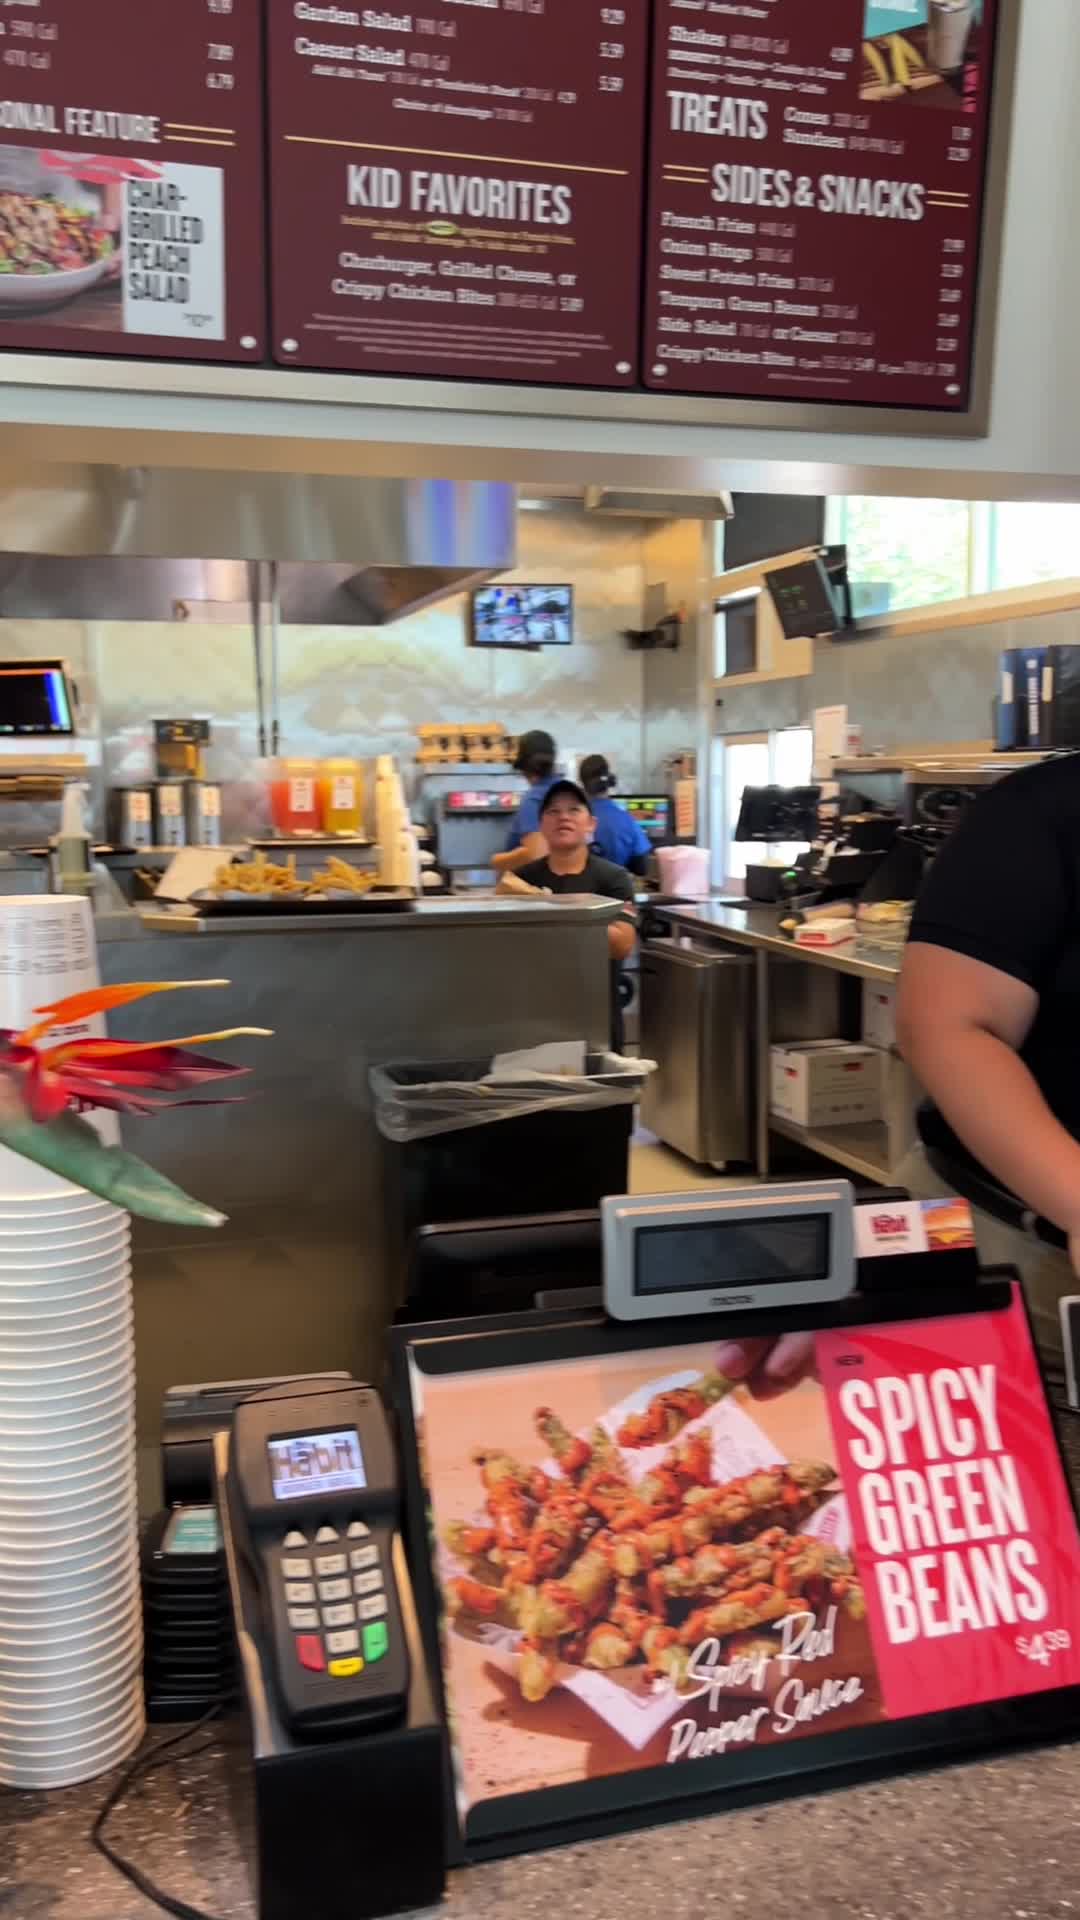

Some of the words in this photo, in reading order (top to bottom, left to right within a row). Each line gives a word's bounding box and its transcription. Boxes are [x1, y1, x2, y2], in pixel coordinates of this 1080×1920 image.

[294, 2, 360, 26] Garden
[361, 10, 413, 32] Salad
[294, 37, 354, 60] Caesar
[354, 44, 407, 66] Salad
[669, 25, 728, 47] Shakes
[64, 107, 160, 143] FEATURE
[667, 91, 769, 140] TREATS
[784, 107, 830, 126] Cones
[782, 128, 847, 149] Sundaes
[127, 179, 187, 211] CHAR-
[346, 164, 400, 209] KID
[411, 171, 573, 225] FAVORITES
[711, 163, 792, 208] SIDES
[794, 176, 815, 207] &
[818, 174, 925, 221] SNACKS
[127, 210, 204, 244] GRILLED
[661, 211, 715, 231] French
[716, 217, 757, 234] Fries
[128, 241, 190, 275] PEACH
[659, 238, 707, 256] Onion
[708, 243, 754, 263] Rings
[128, 272, 189, 304] SALAD
[438, 260, 495, 280] Grilled
[558, 274, 578, 286] or
[658, 265, 707, 282] Sweet
[708, 269, 756, 286] Potato
[757, 273, 797, 289] Fries
[331, 279, 386, 301] Crispy
[387, 283, 455, 303] Chicken
[456, 288, 497, 306] Bites
[657, 291, 726, 311] Tempura
[727, 296, 773, 313] Green
[774, 300, 820, 317] Beans
[657, 317, 692, 333] Side
[693, 319, 738, 336] Salad
[656, 344, 703, 364] Crispy
[703, 347, 761, 365] Chicken
[838, 1364, 1004, 1470] SPICY
[271, 1438, 354, 1480] Habit
[857, 1455, 1029, 1556] GREEN
[873, 1538, 1049, 1645] BEANS
[677, 1637, 771, 1712] Spicy
[772, 1605, 838, 1676] Red
[666, 1706, 770, 1764] Pepper
[772, 1676, 864, 1734] Sauce
